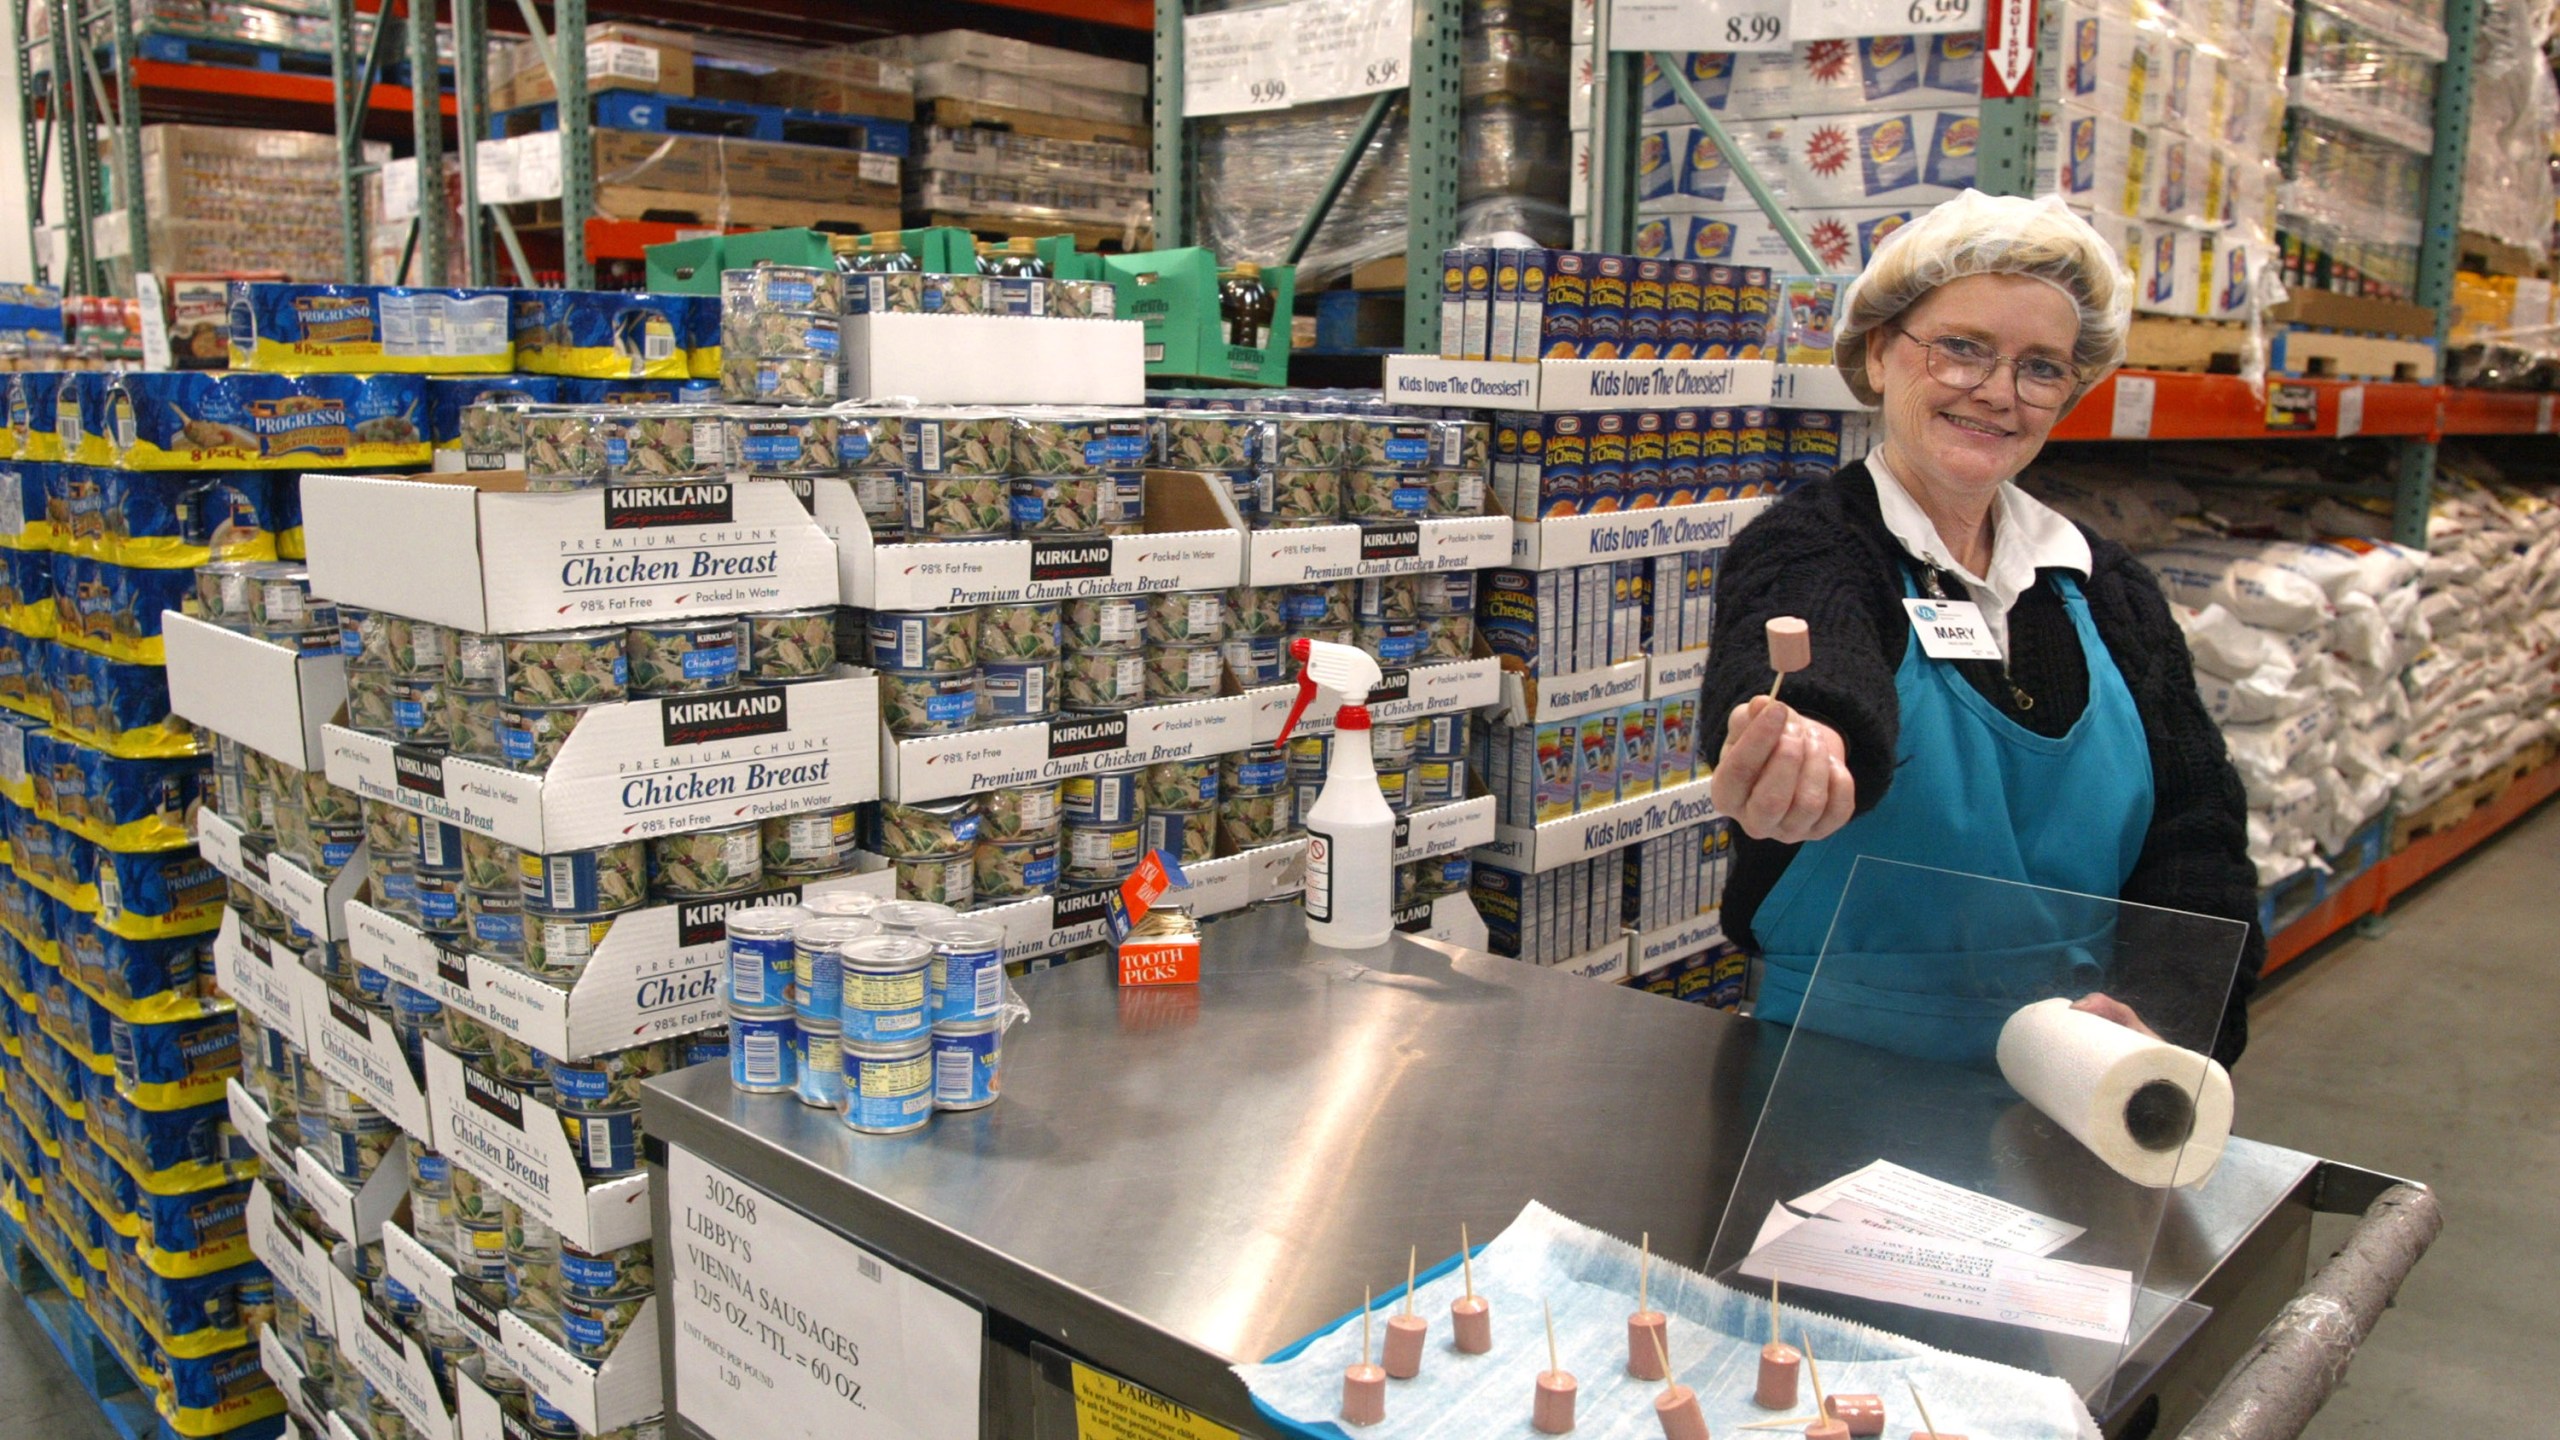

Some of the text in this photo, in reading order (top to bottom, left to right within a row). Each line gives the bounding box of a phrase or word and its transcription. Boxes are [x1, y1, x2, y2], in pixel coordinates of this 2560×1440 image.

[1726, 16, 1781, 43] 8.99
[1251, 80, 1286, 104] 9.99
[298, 306, 371, 324] PROGRESSO
[304, 345, 334, 357] Pack
[1399, 376, 1422, 393] Kids
[1424, 376, 1447, 393] love
[1449, 376, 1468, 394] The
[1590, 370, 1619, 396] Kids
[1622, 369, 1649, 396] love
[1651, 368, 1674, 396] The
[255, 410, 346, 433] PROGRESSO
[206, 446, 246, 462] Pack
[611, 485, 728, 508] KIRKLAND
[561, 529, 777, 550] PREMIUM CHUNK
[1364, 532, 1417, 547] KIRKLAND
[1590, 527, 1620, 554] Kids
[1622, 525, 1649, 549] love
[1650, 520, 1672, 546] The
[562, 550, 777, 587] Chicken Breast
[920, 550, 1215, 575] 98% Fat Free Packed Water
[1036, 547, 1109, 566] KIRKLAND
[1304, 554, 1468, 580] Premium Chunk Chicken Breast
[581, 587, 780, 612] 98% Fat Free Packed In Water
[949, 575, 1180, 604] Premium Chunk Chicken Breast
[1490, 601, 1534, 622] Cheese
[1933, 626, 1976, 640] MARY
[1659, 667, 1693, 685] Kids love
[1550, 684, 1604, 708] Kids love The
[669, 695, 782, 725] KIRKLAND
[1293, 694, 1458, 732] Premiu Chicken Breast
[943, 715, 1227, 764] 98% Fat Free Packed Water
[1053, 720, 1124, 744] KIRKLAND
[396, 755, 441, 781] KIRKLAND
[620, 737, 828, 773] PREMIUM CHUNK
[971, 742, 1192, 790] Premium Chunk Chicken Breast
[622, 758, 830, 808] Chicken Breast
[359, 775, 494, 832] Premium Chunk Chicken Breast
[641, 795, 832, 832] 98% Fat Free Packed In Water
[1585, 795, 1714, 851] Kids love The Cheesies
[1427, 838, 1457, 854] Breast
[1057, 887, 1120, 915] KIRKLAN
[1049, 925, 1093, 947] Chunk
[636, 950, 725, 975] PREMIU
[1121, 948, 1183, 969] TOOTH
[1644, 944, 1661, 960] Kids
[1122, 963, 1178, 983] PICKS
[383, 953, 519, 1032] Premium Chicken Breast
[637, 969, 717, 1010] Chick
[654, 1009, 722, 1031] 98% Fat Free
[362, 1057, 395, 1097] Breast
[465, 1066, 520, 1111] KIRKLAND
[452, 1114, 550, 1195] Chicken Breast
[705, 1174, 757, 1225] 30268
[686, 1206, 752, 1264] LIBBY'S
[687, 1243, 859, 1367] VIENNA SAUSAGES
[684, 1320, 774, 1389] UNIT PRICE PER POUND
[694, 1279, 721, 1314] 12/5
[726, 1301, 753, 1336] OZ.
[757, 1320, 791, 1361] TTL
[811, 1358, 831, 1386] 60
[835, 1373, 866, 1411] OZ.
[719, 1365, 741, 1390] 1.20
[1117, 1380, 1192, 1424] PARENTS
